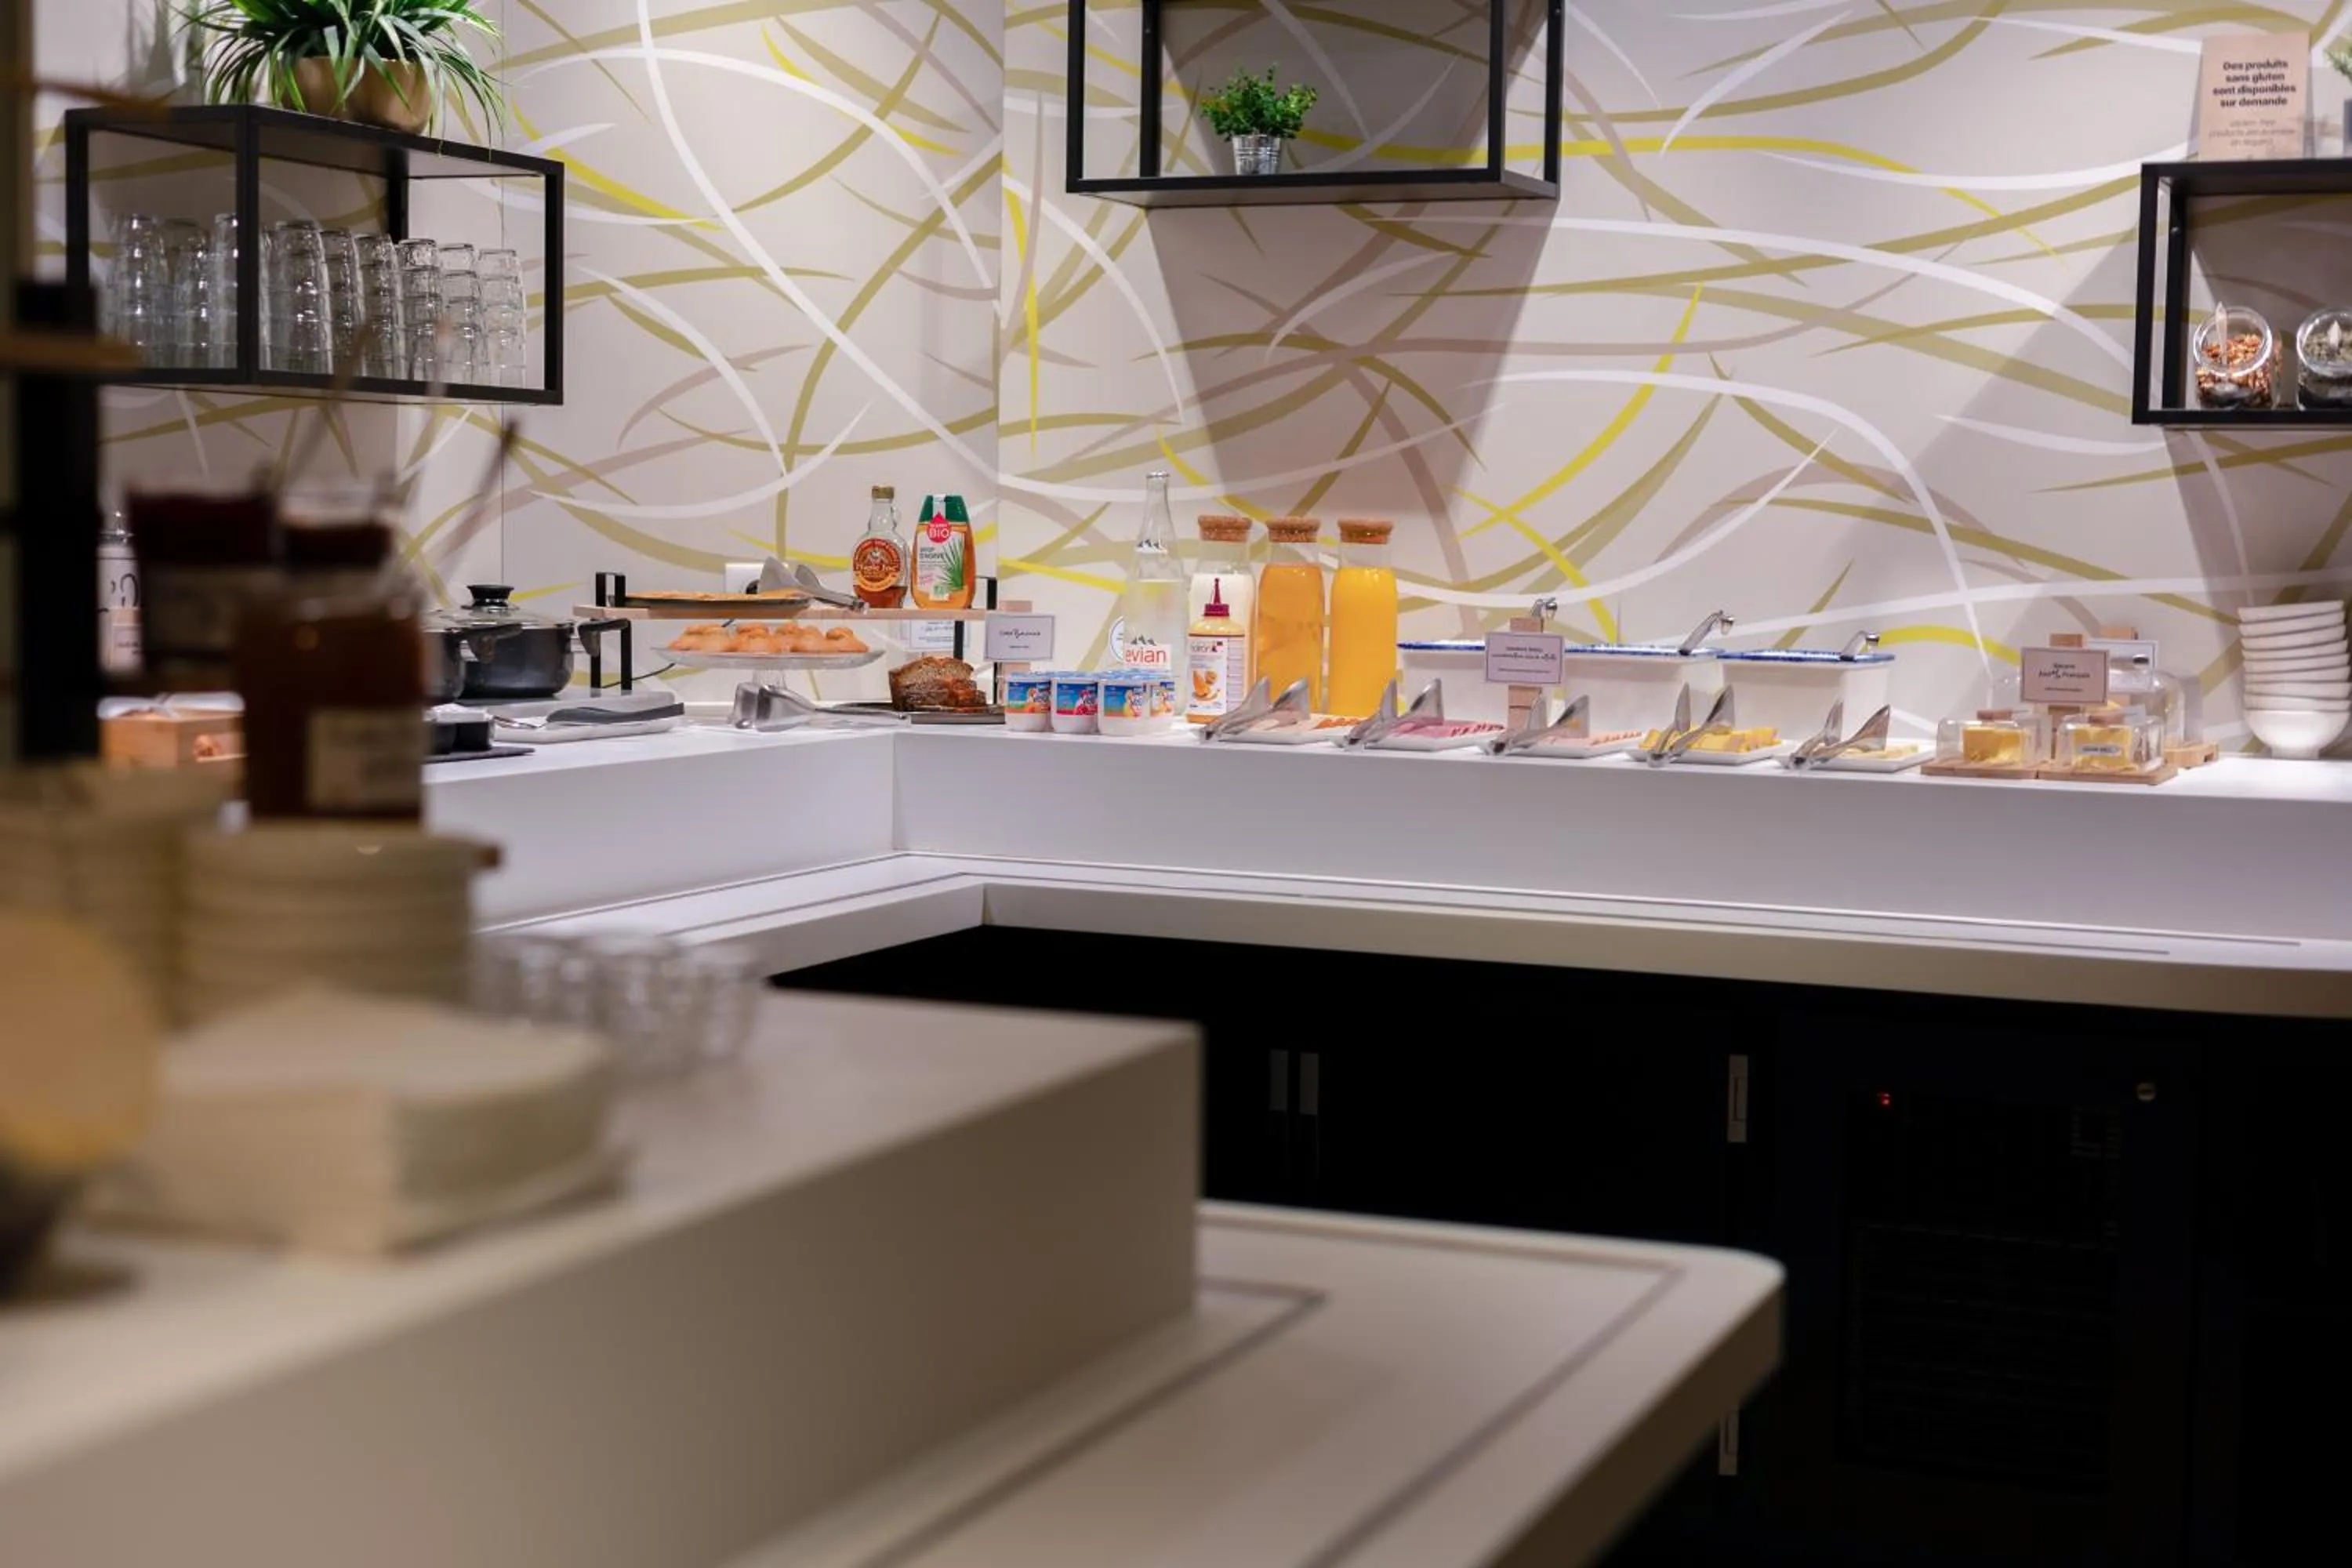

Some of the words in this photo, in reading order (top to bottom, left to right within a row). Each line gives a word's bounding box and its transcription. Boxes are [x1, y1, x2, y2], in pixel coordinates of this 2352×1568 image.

[2245, 59, 2288, 71] produits
[2252, 72, 2285, 84] gluten
[2212, 86, 2235, 95] sont
[2237, 83, 2296, 96] disponibles
[2220, 99, 2236, 107] sur
[2238, 95, 2288, 107] demande
[929, 526, 949, 539] BIO
[1125, 647, 1167, 663] evian
